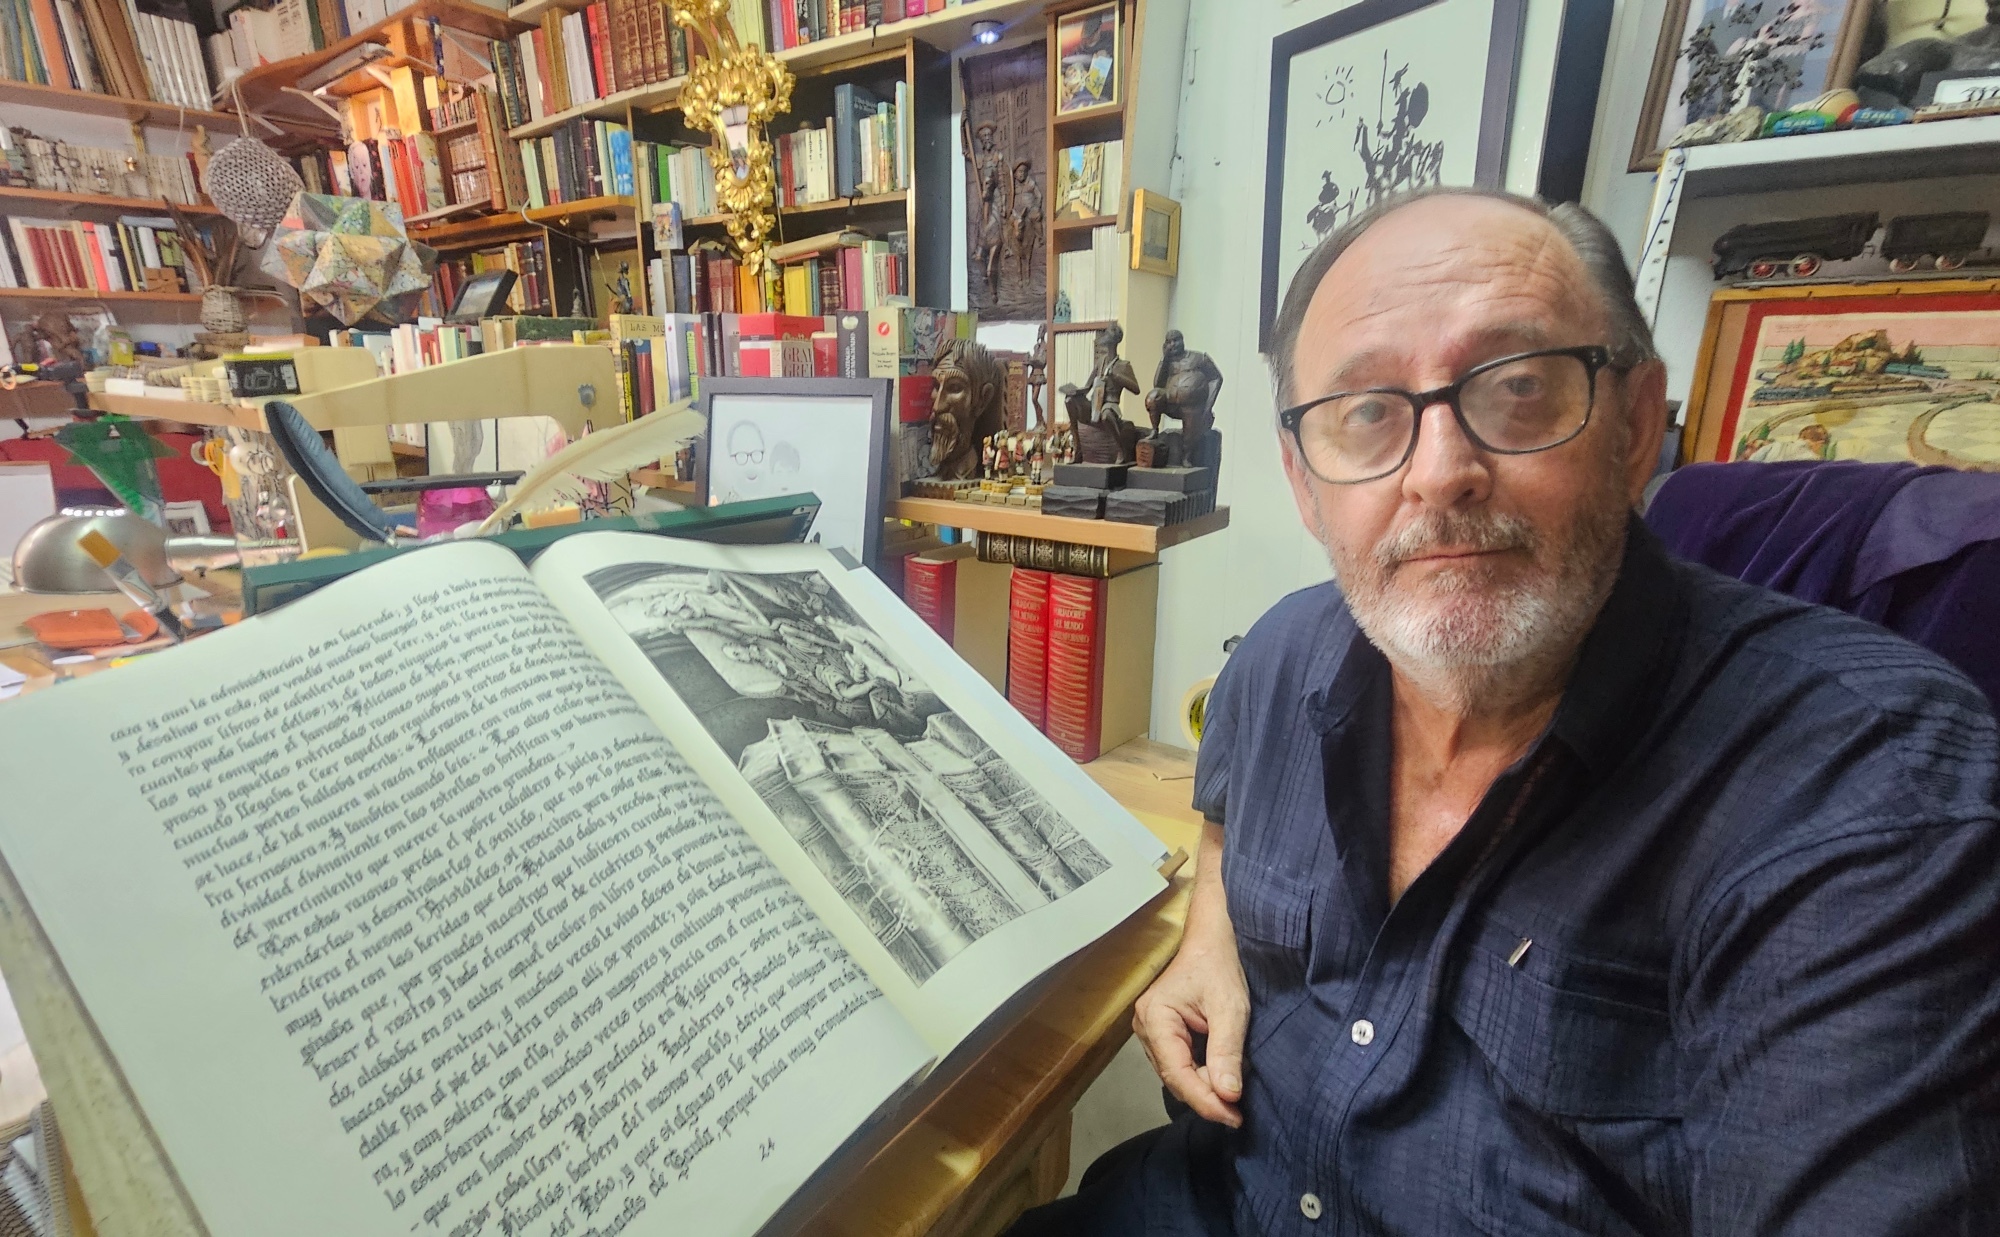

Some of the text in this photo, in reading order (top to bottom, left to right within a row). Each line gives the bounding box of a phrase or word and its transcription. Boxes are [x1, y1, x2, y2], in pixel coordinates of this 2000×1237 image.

[630, 323, 647, 332] LAS
[173, 693, 461, 851] cuando llegaba leer aquellos requiebros
[182, 828, 249, 870] muchas
[253, 805, 301, 838] partes
[299, 774, 356, 811] hallaba
[220, 732, 550, 929] divinidad divinamente con estrellas fortifican
[262, 752, 557, 933] merecimiento que merece vuestra grandeza
[303, 909, 341, 940] estas
[344, 874, 399, 914] razones
[461, 811, 497, 843] pobre
[498, 775, 551, 817] caballero
[305, 796, 361, 833] manera
[400, 769, 446, 805] cuando
[260, 929, 355, 994] entenderlas
[268, 965, 342, 1014] tendiera
[360, 920, 414, 961] mesmo
[518, 808, 583, 855] resucitara
[311, 844, 644, 1082] tener rostro todo cuerpo lleno cicatrices
[321, 984, 360, 1011] bien
[360, 966, 387, 990] con
[413, 910, 471, 955] heridas
[357, 877, 635, 1089] alababa autor aquel acabar libro
[397, 970, 424, 1001] por
[427, 930, 484, 985] grandes
[485, 882, 549, 936] maestros
[571, 827, 631, 870] hubiesen
[340, 1066, 426, 1134] inacabable
[513, 962, 565, 1010] muchas
[565, 933, 601, 968] veces
[612, 903, 640, 931] vino
[640, 879, 675, 912] deseo
[358, 1120, 401, 1160] dalle
[399, 1101, 429, 1128] fin
[447, 1070, 470, 1097] pie
[470, 1051, 491, 1077] de
[487, 1040, 509, 1060] la
[503, 1013, 543, 1048] letra
[543, 984, 579, 1020] como
[384, 1188, 407, 1212] lo
[541, 1040, 593, 1090] muchas
[593, 1007, 631, 1045] veces
[632, 948, 706, 1015] competencia
[739, 907, 766, 930] cura
[412, 1128, 443, 1157] aun
[443, 1086, 497, 1137] saliera
[552, 1023, 570, 1048] si
[570, 995, 604, 1032] otros
[605, 952, 659, 1002] mayores
[669, 903, 725, 950] continuos
[478, 1123, 537, 1177] hombre
[538, 1089, 578, 1131] docto
[592, 1021, 656, 1090] graduado
[657, 1006, 676, 1028] en
[749, 925, 782, 953] sobre
[565, 1133, 619, 1185] barbero
[645, 1068, 690, 1115] mesmo
[786, 958, 827, 991] ninguno
[673, 1083, 715, 1131] alguno
[715, 1068, 734, 1092] se
[727, 1054, 747, 1075] le
[779, 987, 828, 1032] comparar
[716, 1086, 758, 1135] porque
[813, 993, 869, 1043] acomodada
[759, 1137, 775, 1161] 24
